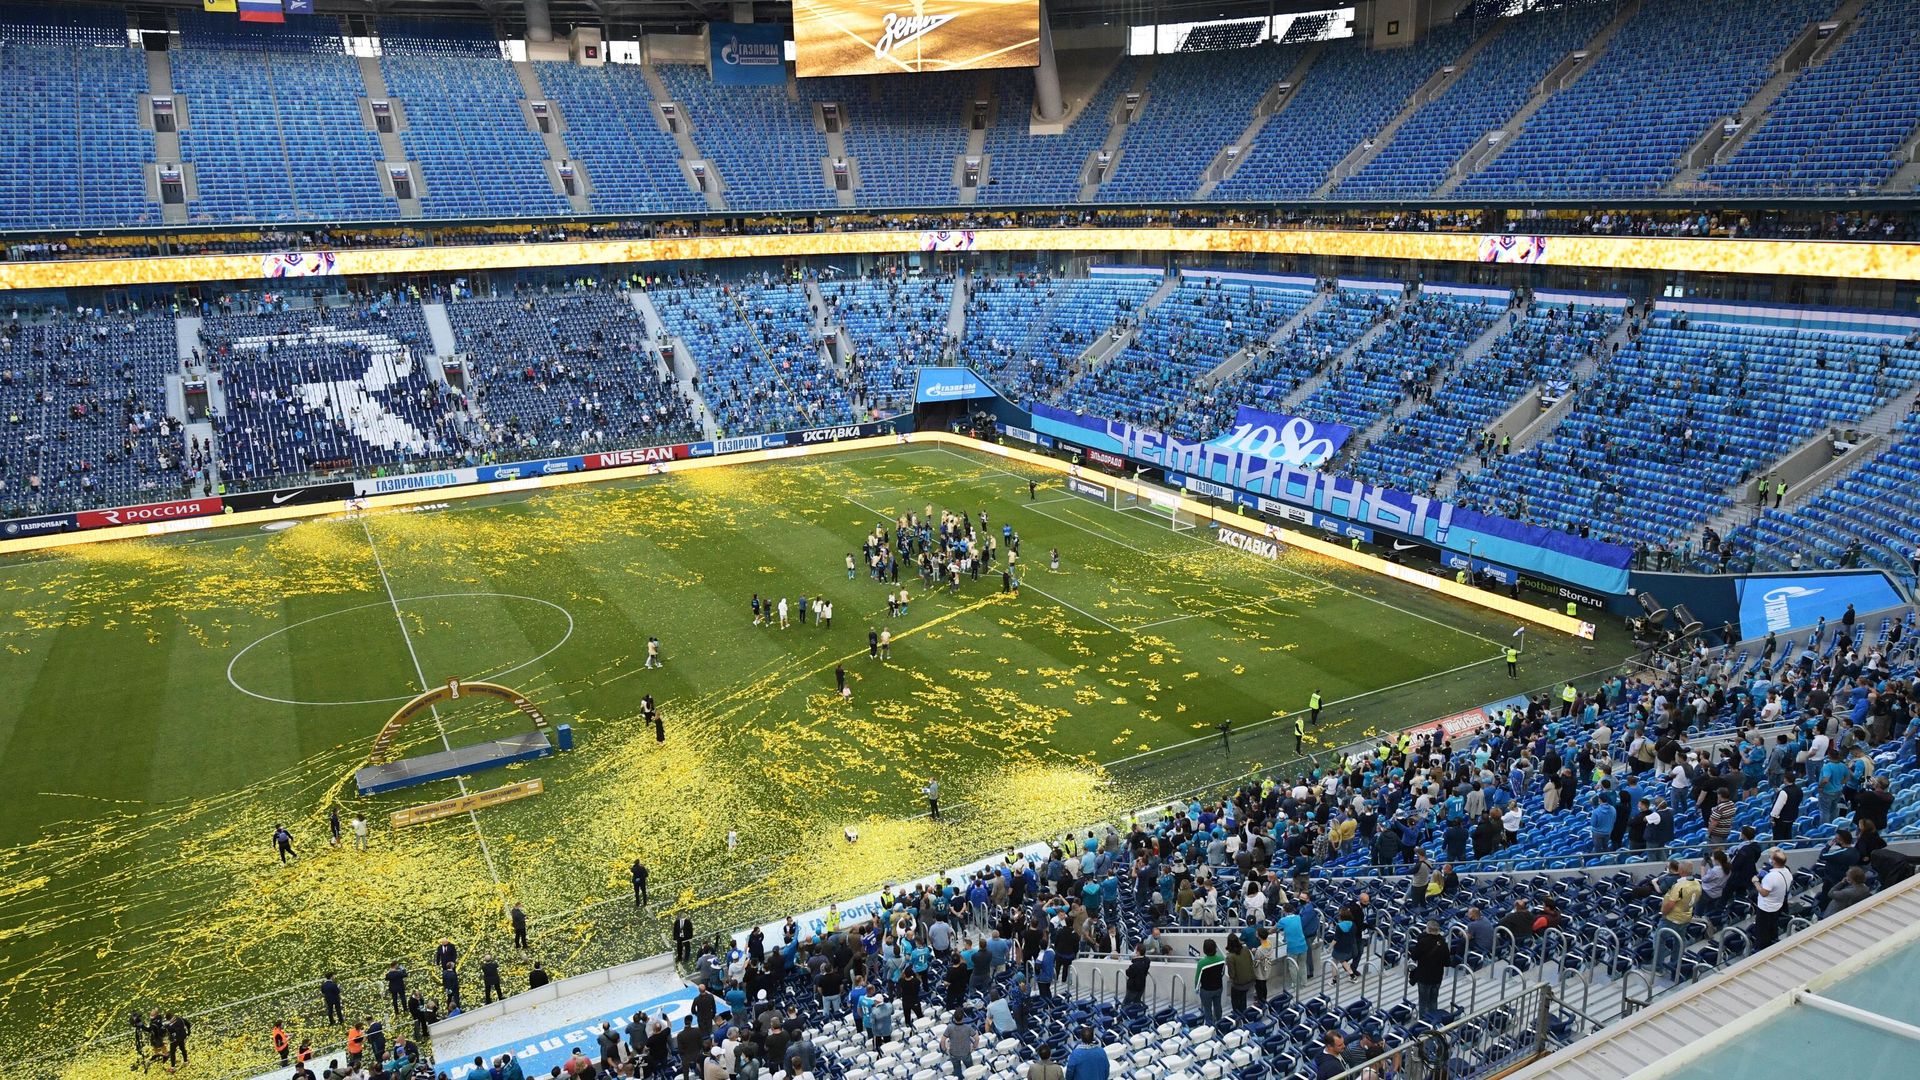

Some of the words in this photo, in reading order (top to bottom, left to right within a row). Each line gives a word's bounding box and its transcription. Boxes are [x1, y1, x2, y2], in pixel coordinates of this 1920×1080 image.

[739, 44, 779, 55] ГАЗПРОМ
[941, 383, 976, 393] ГАЗПРОМ
[718, 438, 758, 451] ГАЗПРОМ
[1217, 417, 1334, 467] 1080
[600, 447, 674, 467] NISSAN
[376, 473, 457, 492] ГАЗПРОМНЕФТЬ
[126, 503, 200, 520] РОССИЯ
